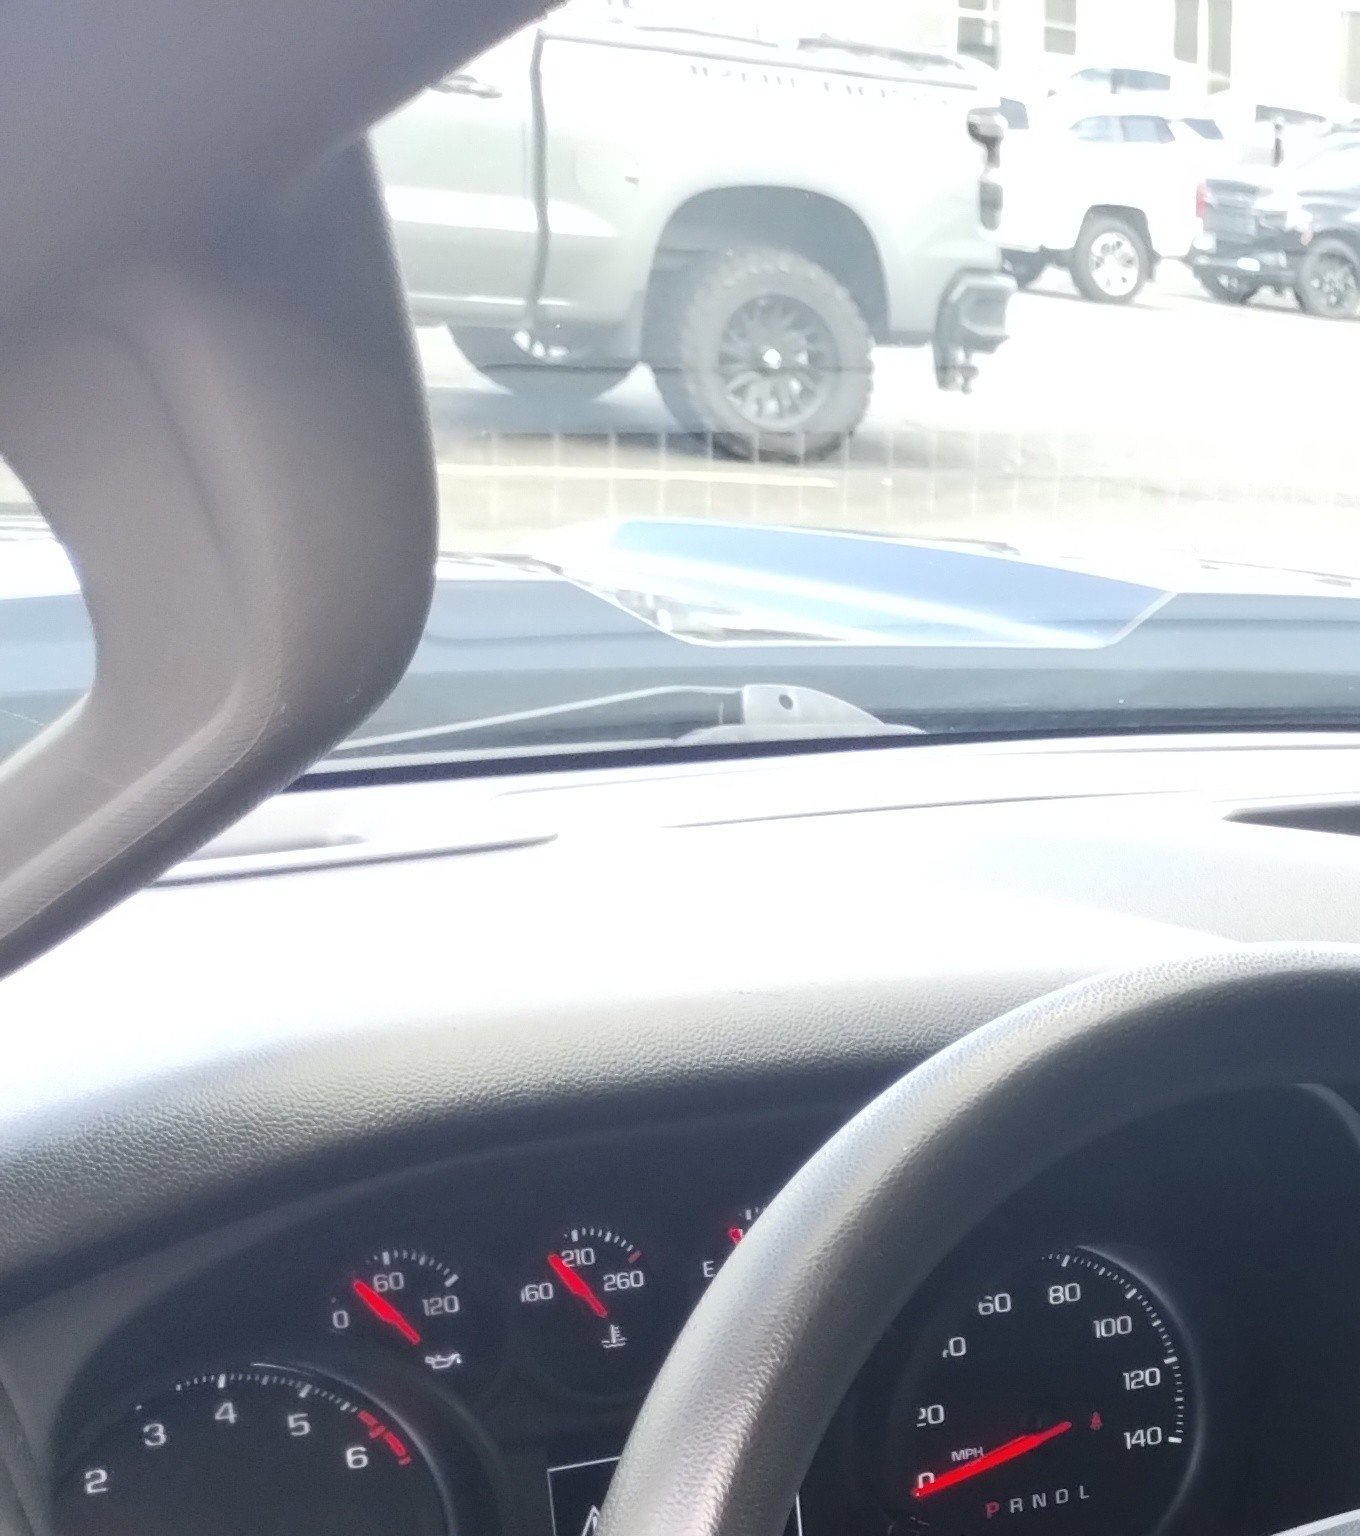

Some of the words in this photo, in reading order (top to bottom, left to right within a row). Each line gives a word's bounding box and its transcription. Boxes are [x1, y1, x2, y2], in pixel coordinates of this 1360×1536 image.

[562, 1246, 595, 1268] 210
[603, 1270, 644, 1291] 260
[703, 1261, 717, 1277] E
[374, 1271, 405, 1293] 60
[1048, 1282, 1081, 1305] 80
[422, 1296, 460, 1316] 120
[978, 1293, 1012, 1316] 60
[332, 1309, 349, 1329] 0
[1093, 1315, 1133, 1339] 100
[942, 1336, 967, 1358] 0
[1123, 1367, 1161, 1390] 120
[214, 1401, 238, 1424] 4
[143, 1423, 167, 1447] 3
[287, 1413, 311, 1436] 5
[1123, 1426, 1163, 1450] 140
[345, 1446, 369, 1469] 6
[951, 1446, 984, 1462] MPH
[84, 1469, 108, 1494] 2
[1009, 1498, 1024, 1514] R
[1032, 1493, 1047, 1508] N
[1056, 1489, 1070, 1504] D
[1079, 1485, 1090, 1500] L
